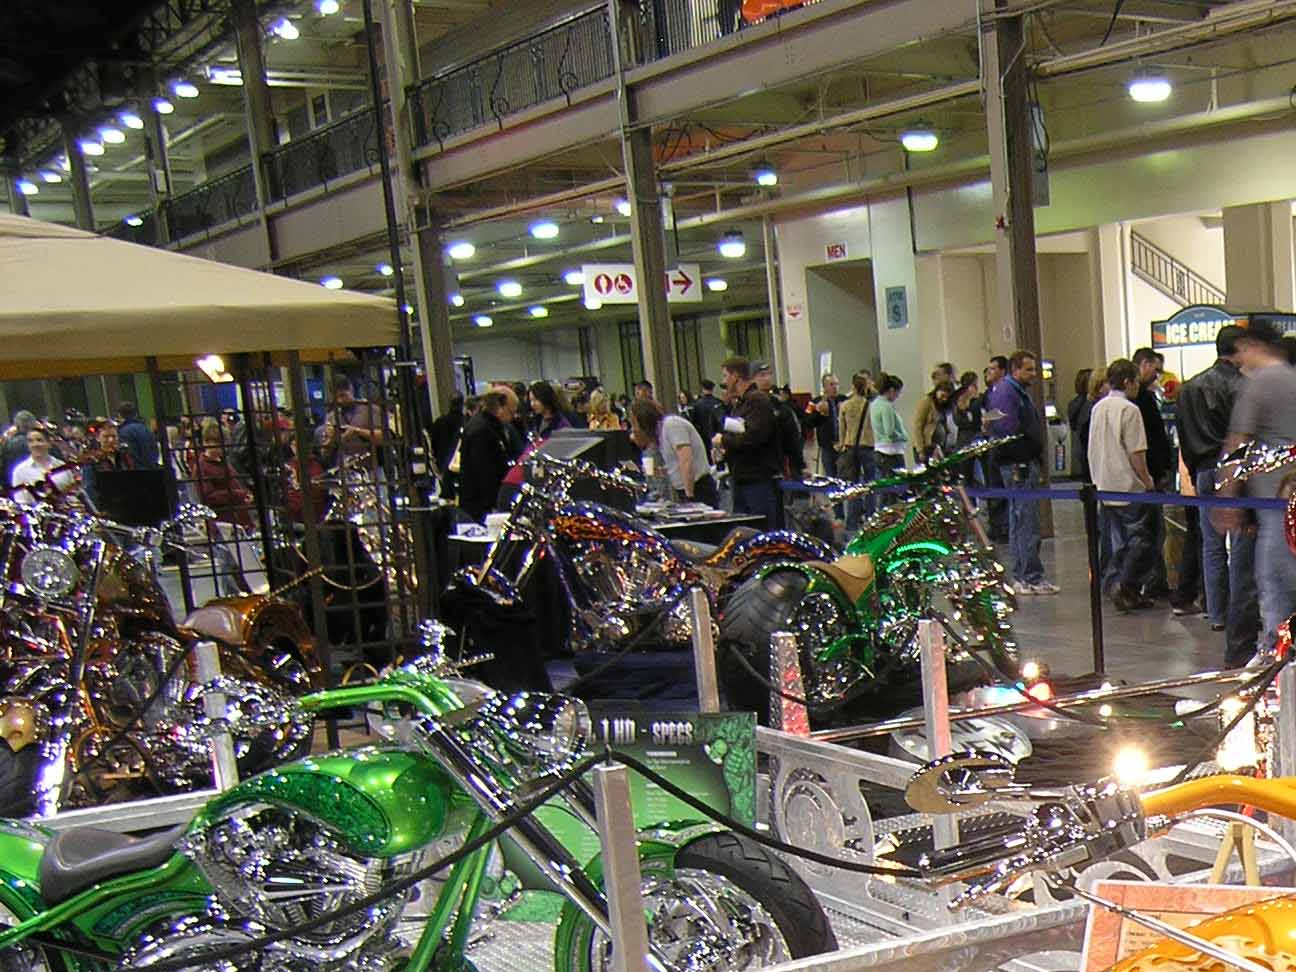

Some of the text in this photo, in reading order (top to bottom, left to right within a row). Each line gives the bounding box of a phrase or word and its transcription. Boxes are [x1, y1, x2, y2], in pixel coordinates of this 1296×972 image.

[826, 243, 846, 258] MEN
[1166, 319, 1236, 344] ICE CRE
[651, 720, 694, 745] SPECS
